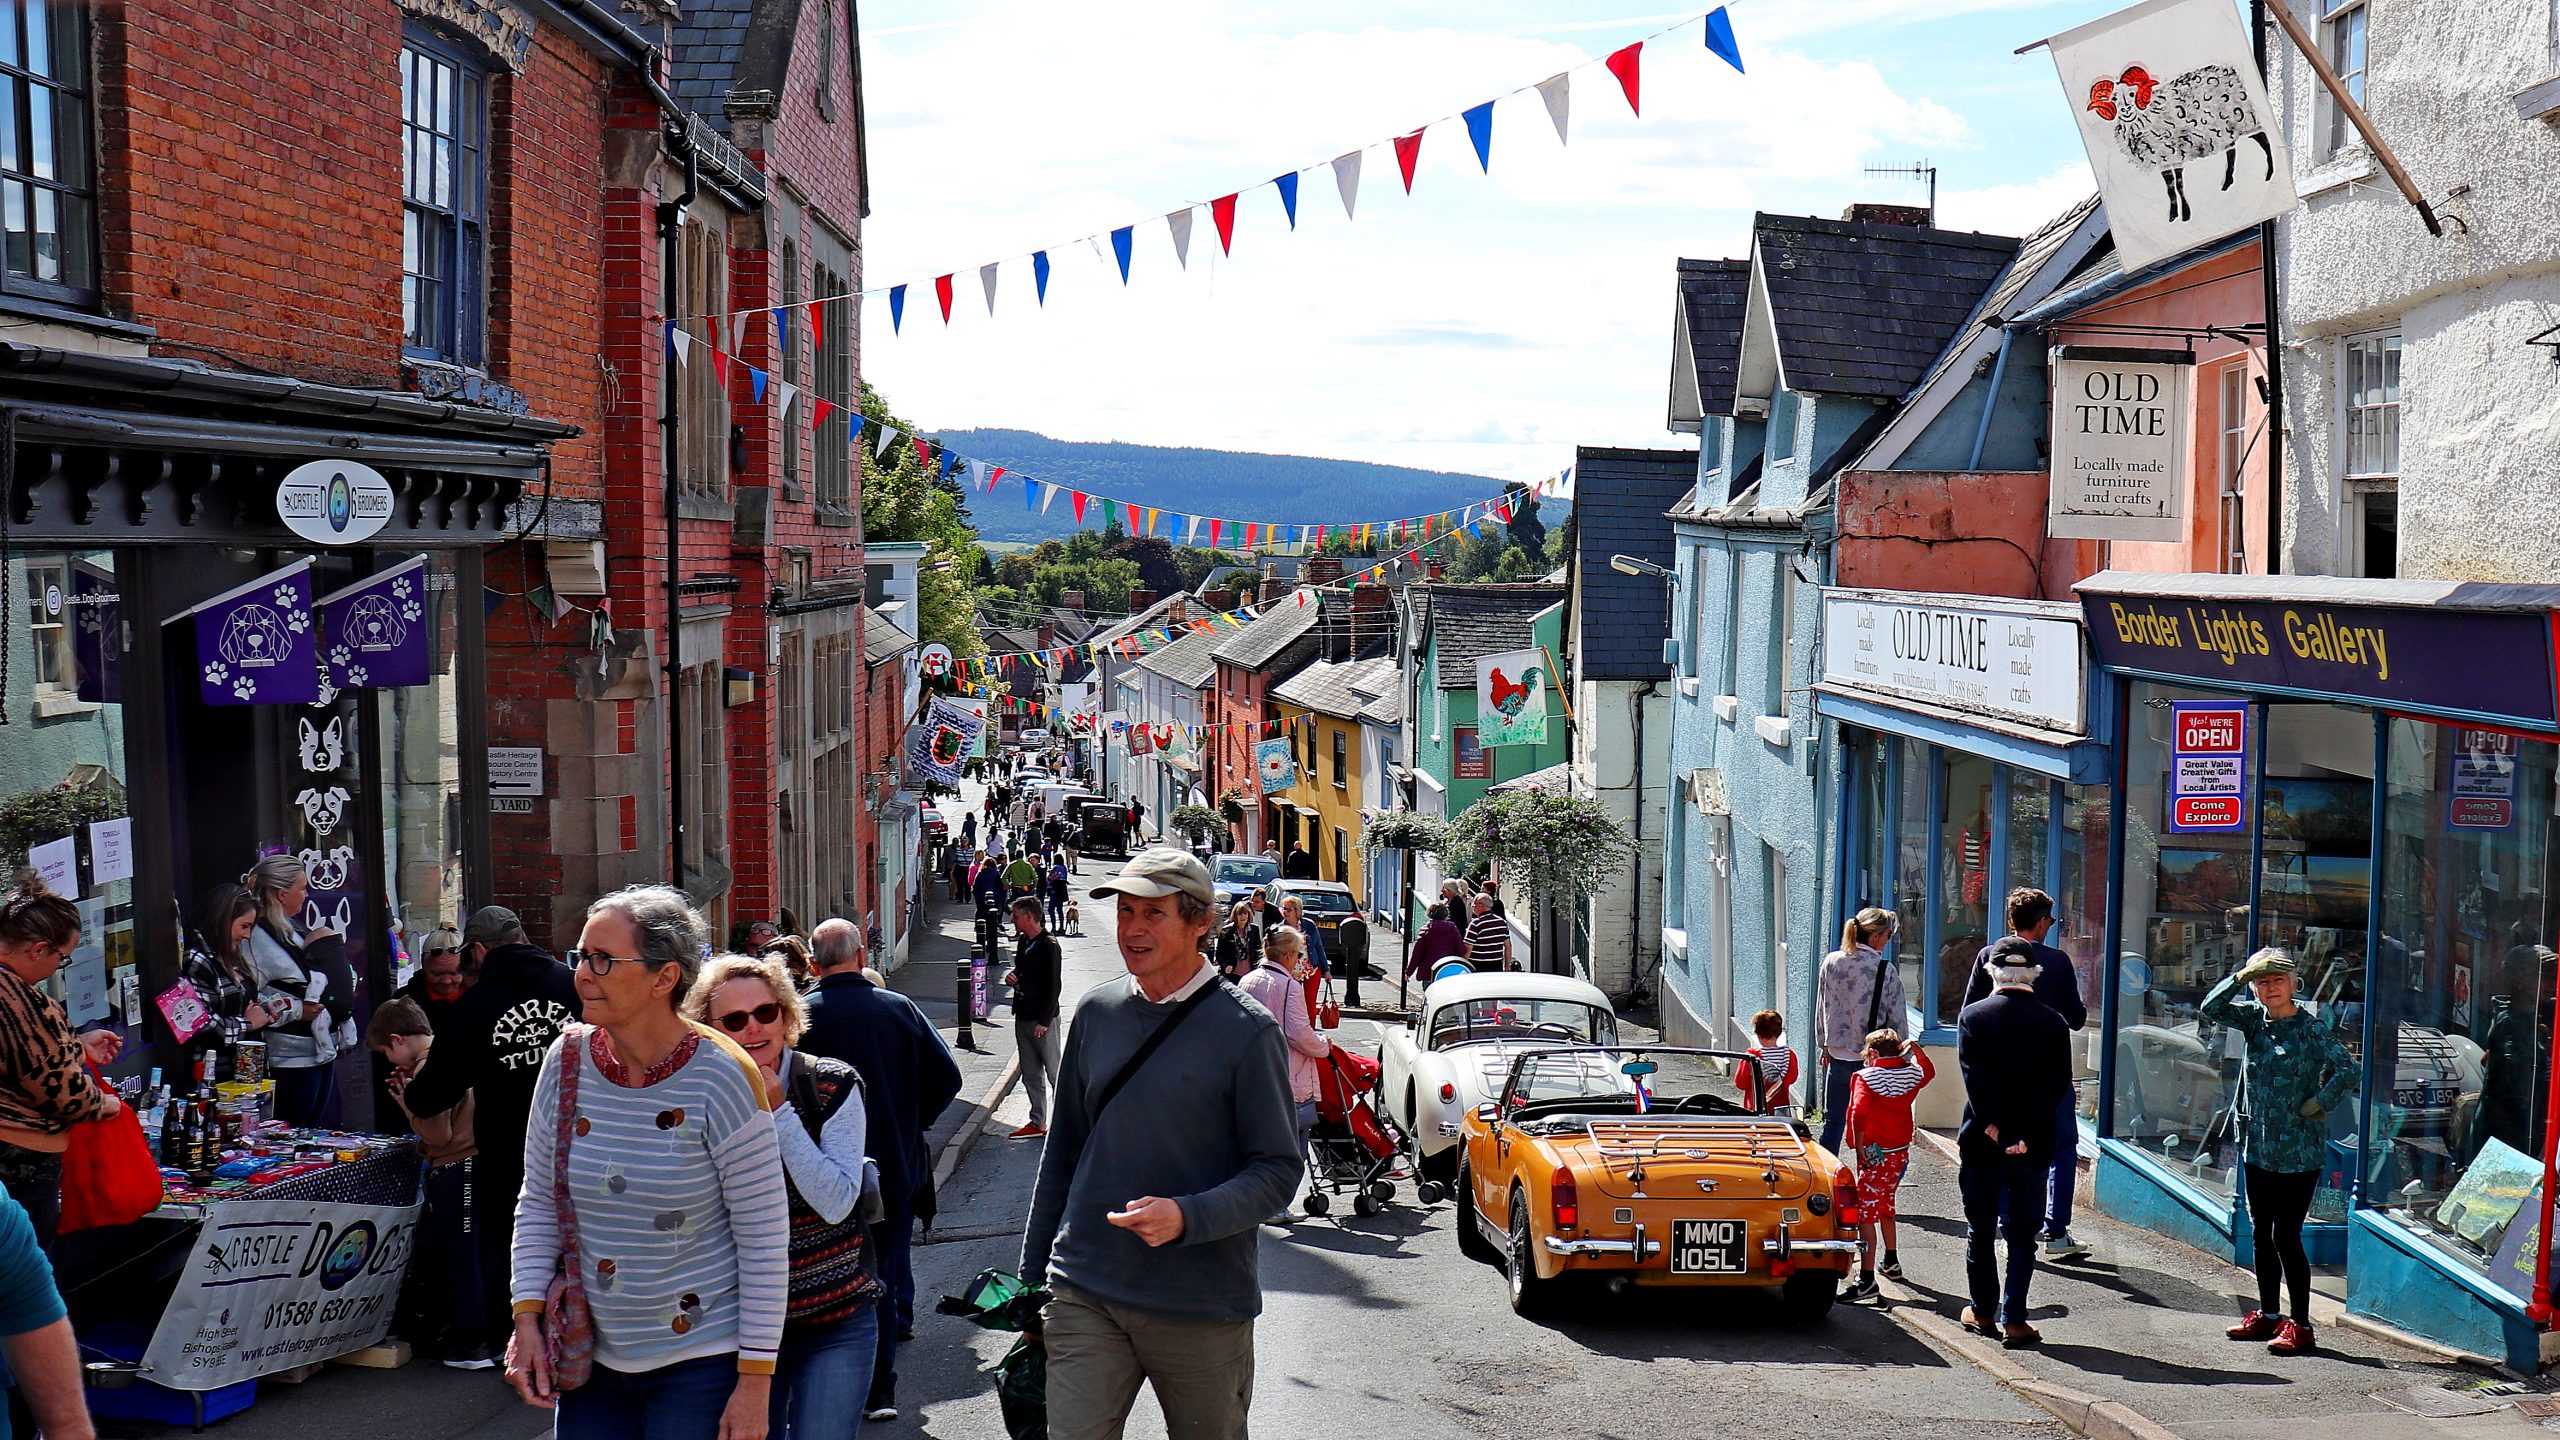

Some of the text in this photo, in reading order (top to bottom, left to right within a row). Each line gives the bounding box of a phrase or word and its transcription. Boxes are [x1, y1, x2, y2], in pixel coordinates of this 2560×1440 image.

[2084, 372, 2159, 402] OLD
[2075, 405, 2166, 436] TIME
[2073, 456, 2165, 473] Locally made
[2086, 473, 2151, 488] furniture
[294, 492, 319, 511] CASTLE
[357, 495, 388, 511] GROOMERS
[2083, 490, 2152, 504] and crafts
[1857, 609, 1876, 634] Locally
[1858, 636, 1874, 652] made
[1893, 609, 1989, 673] OLD TIME
[2008, 625, 2036, 654] Locally
[2110, 602, 2389, 680] Border Lights Gallery
[1854, 653, 1879, 676] furniture
[2011, 654, 2032, 676] made
[1948, 678, 1967, 699] 01588
[2010, 682, 2032, 704] crafts
[2189, 716, 2234, 728] Yes! WE'RE
[2185, 728, 2234, 747] OPEN
[508, 751, 538, 760] Heritage
[2211, 760, 2233, 768] Value
[514, 769, 539, 777] Centre
[2181, 768, 2237, 776] Creative Gifts
[2184, 783, 2236, 792] Local Artists
[500, 799, 532, 811] YARD
[2191, 801, 2226, 810] Come
[2185, 813, 2231, 823] Explore
[973, 970, 985, 1016] OPEN
[464, 1155, 473, 1172] XTN
[1684, 1222, 1735, 1245] MMO
[2525, 1223, 2541, 1241] Ar
[231, 1234, 300, 1268] CASTLE
[1681, 1248, 1737, 1271] 105L
[264, 1301, 317, 1330] 01588
[319, 1298, 354, 1324] 630
[352, 1293, 384, 1319] 760
[196, 1328, 220, 1341] High
[182, 1343, 220, 1355] Bishops
